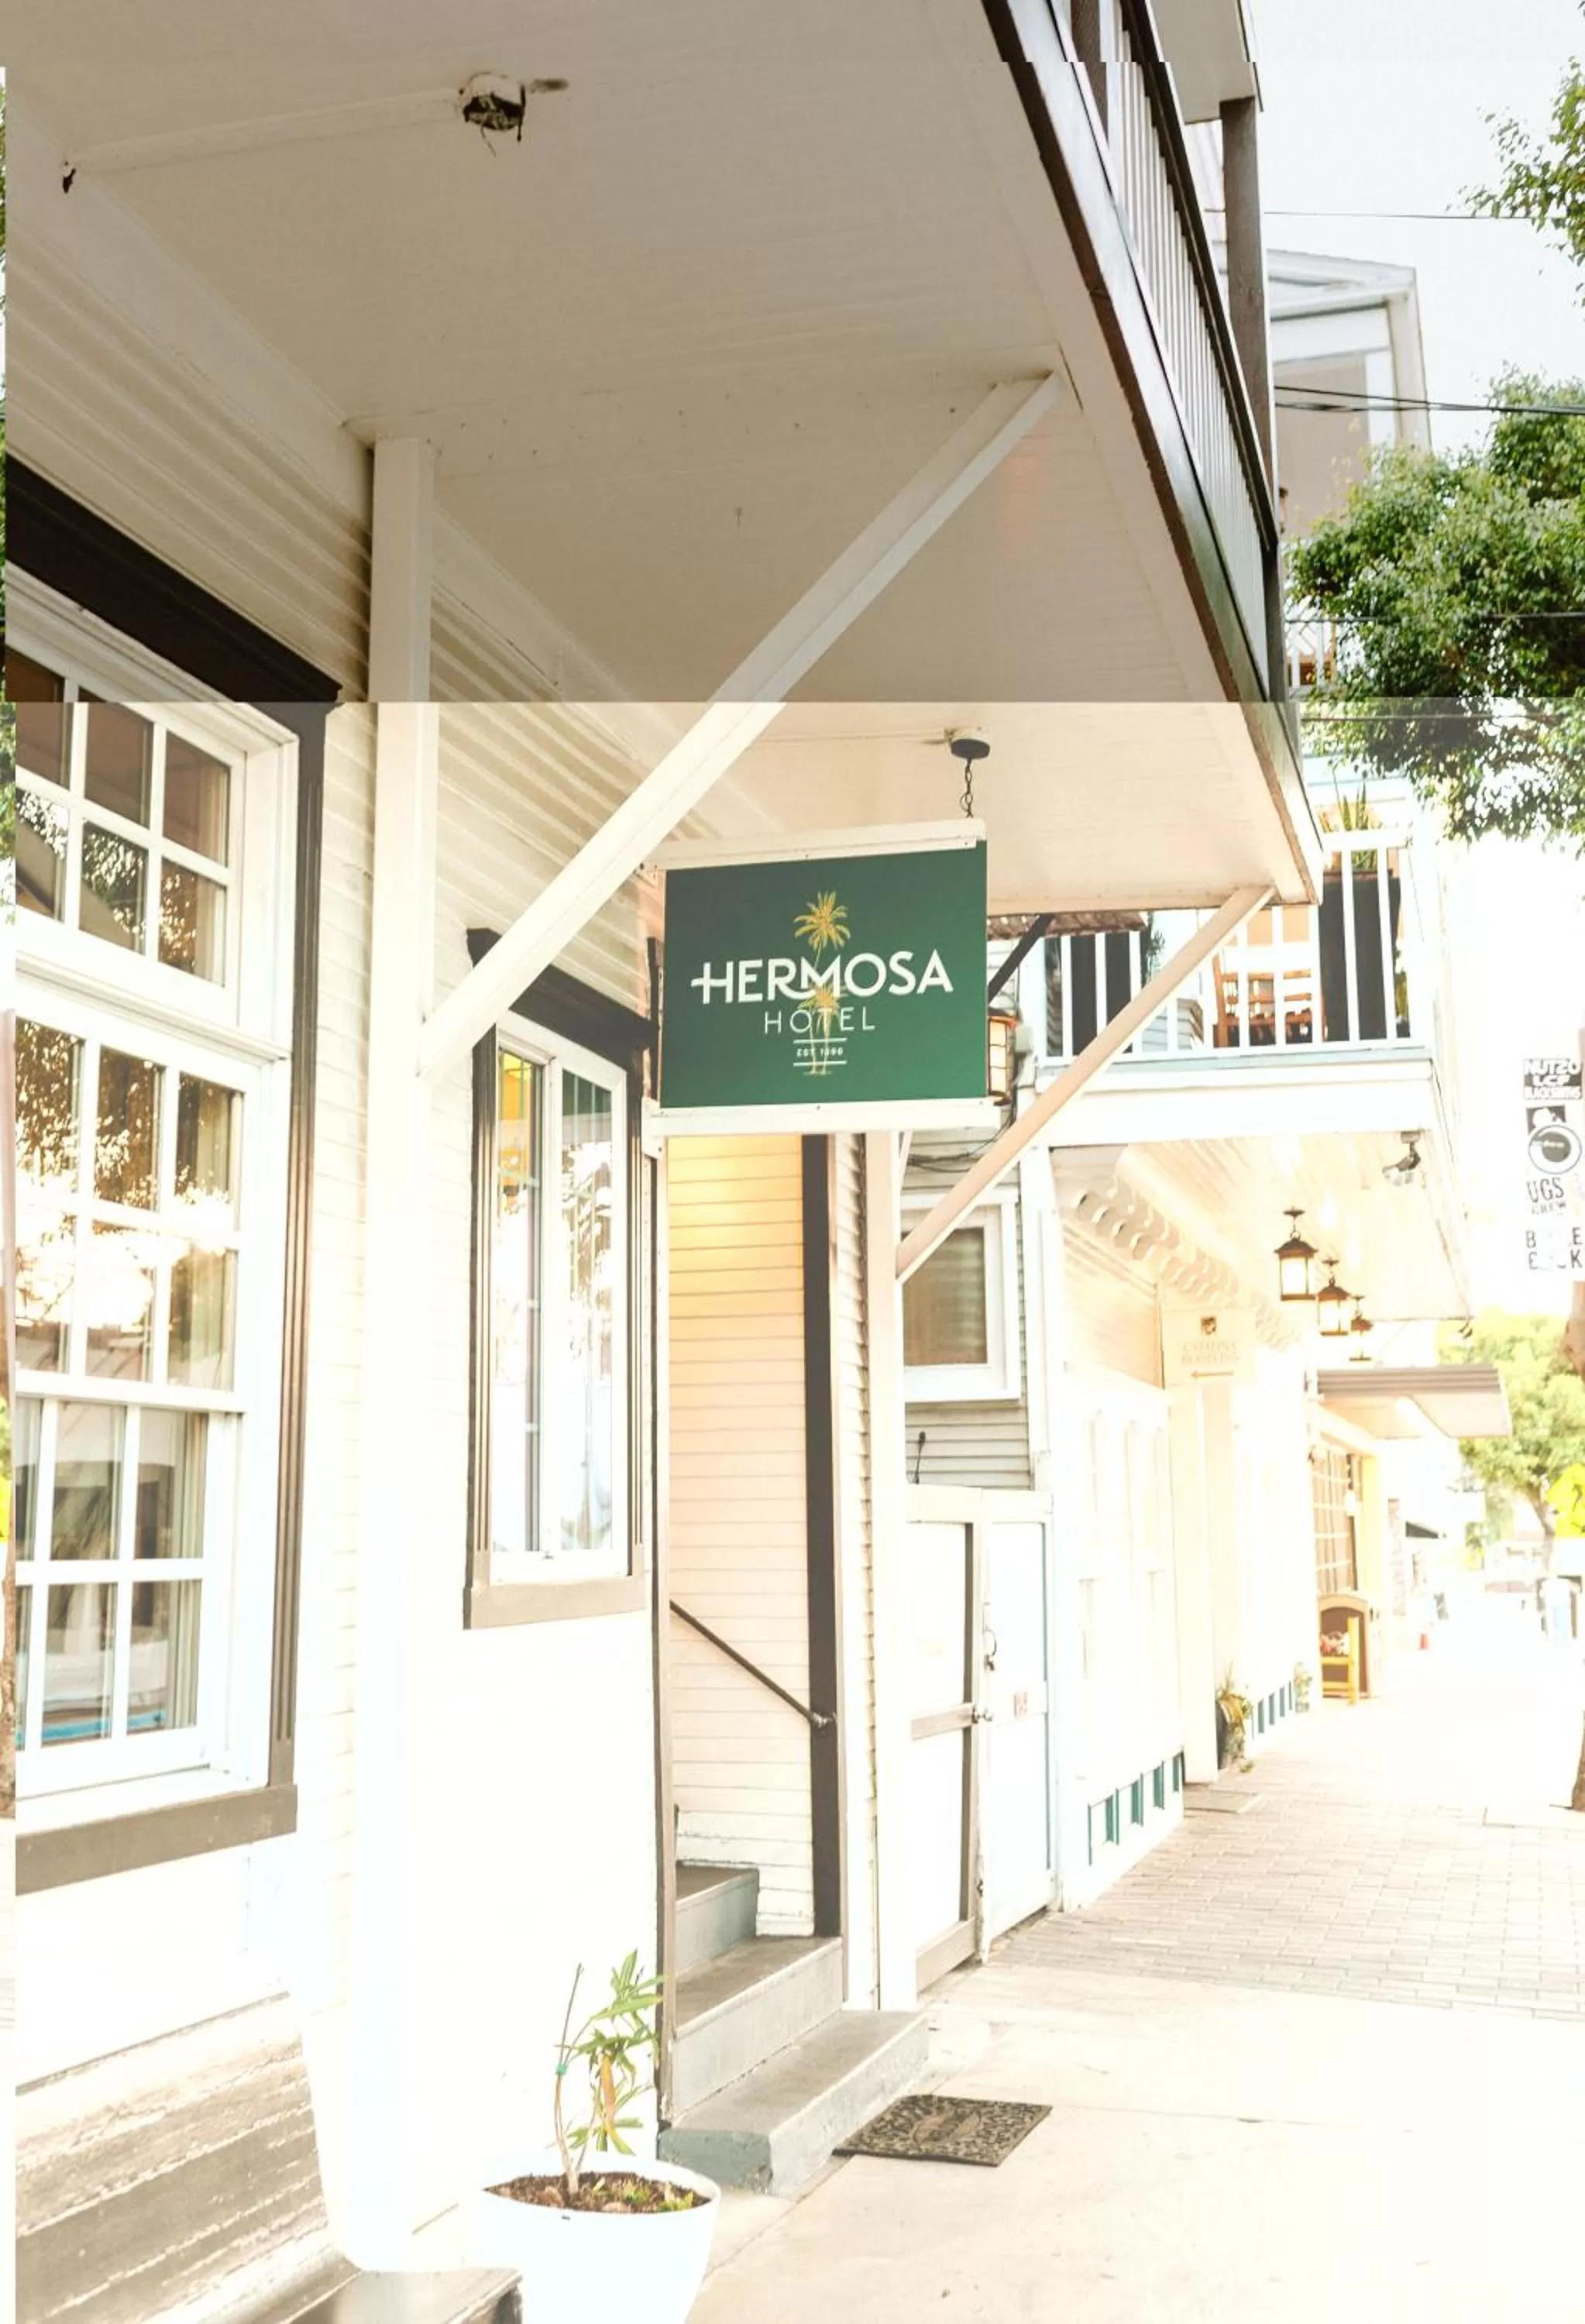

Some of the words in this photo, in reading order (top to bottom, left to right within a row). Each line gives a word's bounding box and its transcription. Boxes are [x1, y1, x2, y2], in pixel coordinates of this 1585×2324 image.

[691, 949, 954, 1004] HERMOSA
[764, 1007, 875, 1033] HOTEL
[796, 1048, 815, 1057] EST
